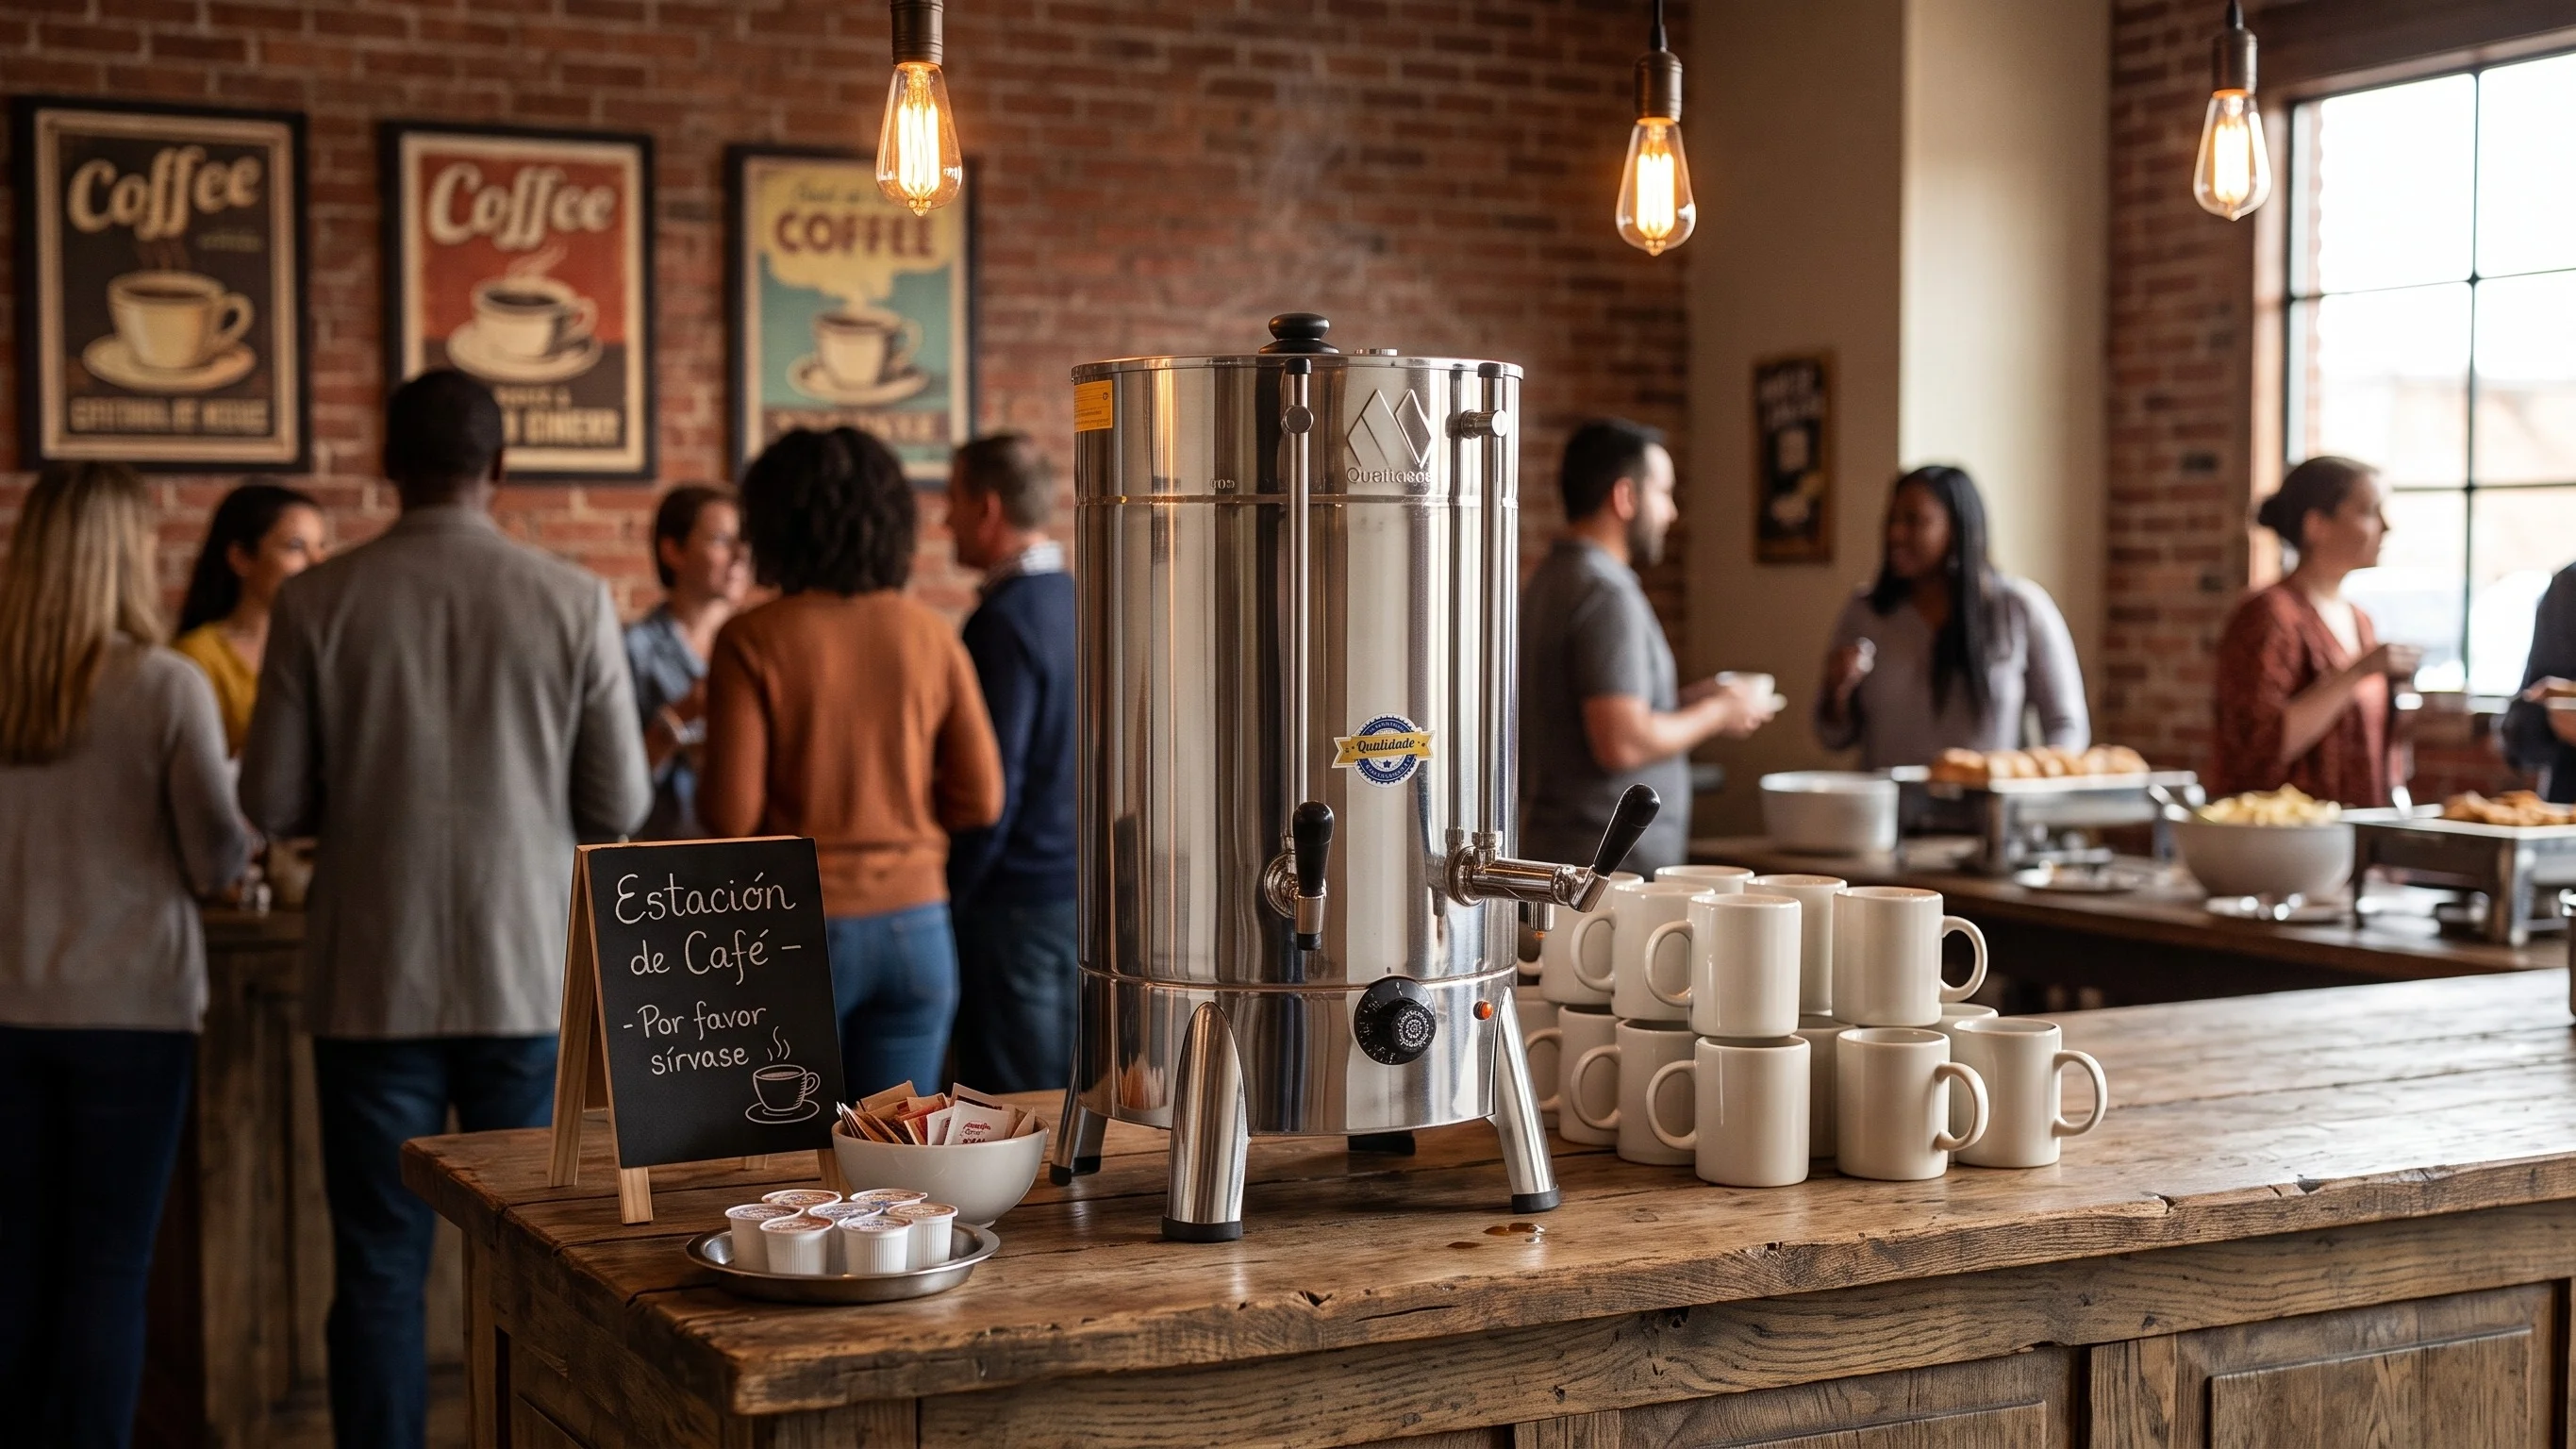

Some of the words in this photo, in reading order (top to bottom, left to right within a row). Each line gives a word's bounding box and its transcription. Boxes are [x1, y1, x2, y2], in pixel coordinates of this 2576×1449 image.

[67, 144, 262, 242] Coffee
[427, 161, 617, 253] Coffee
[1356, 737, 1415, 754] Qualidade
[615, 871, 797, 924] Estación
[629, 939, 671, 976] de
[684, 928, 770, 986] Café
[693, 1000, 767, 1041] favor
[651, 1045, 750, 1075] sírvase
